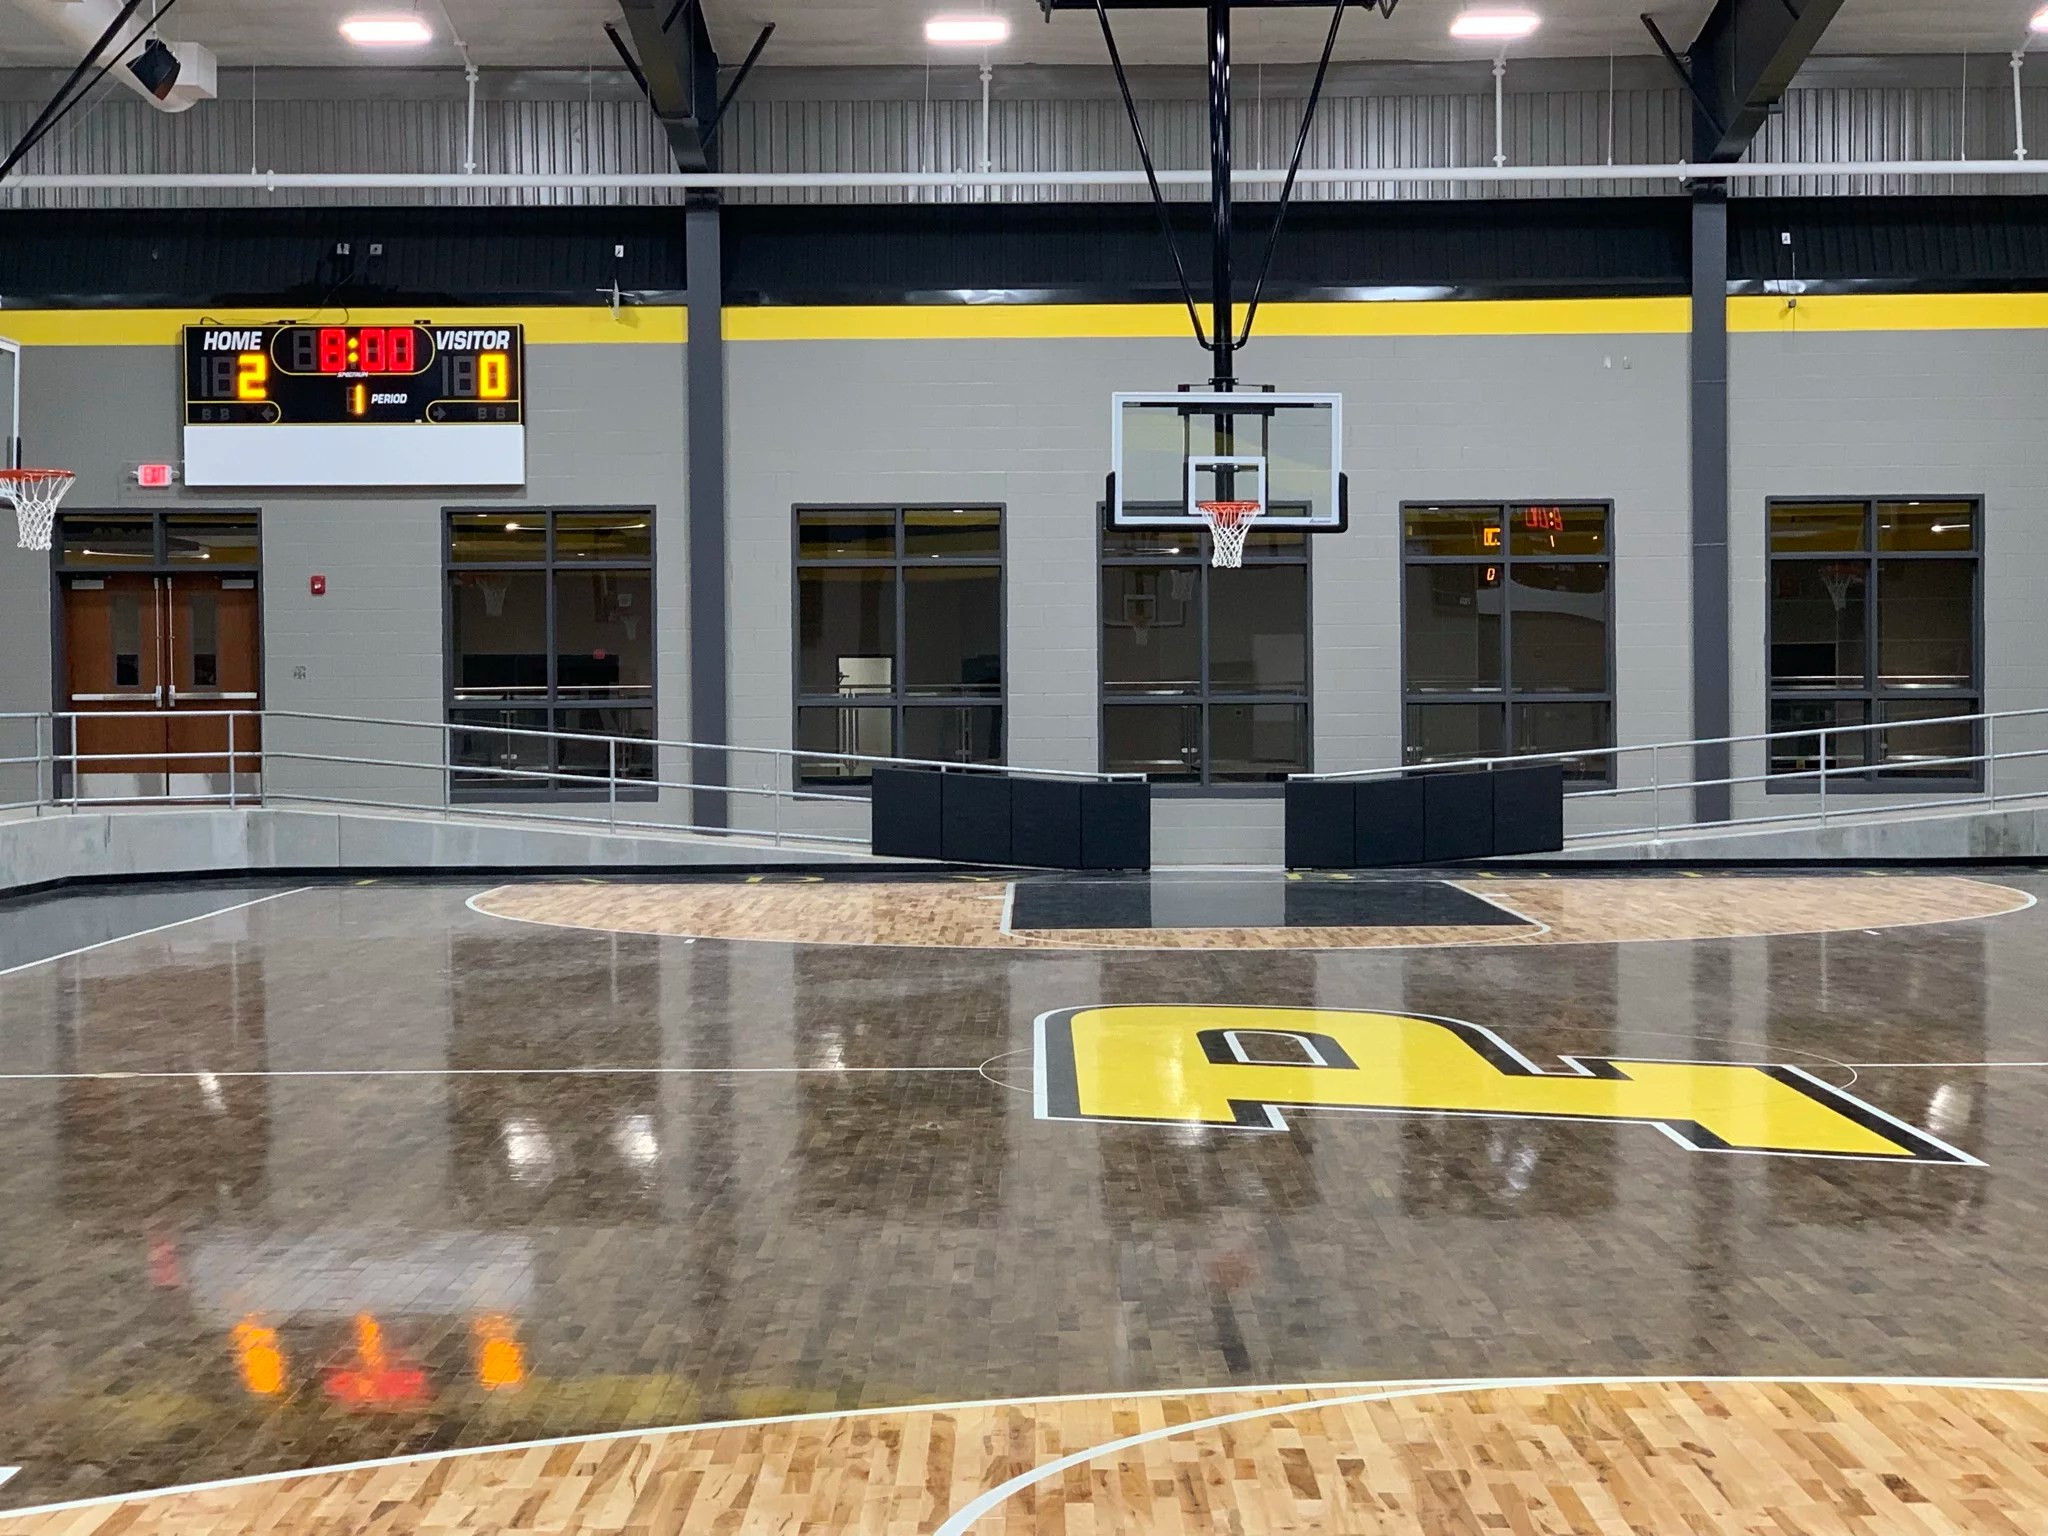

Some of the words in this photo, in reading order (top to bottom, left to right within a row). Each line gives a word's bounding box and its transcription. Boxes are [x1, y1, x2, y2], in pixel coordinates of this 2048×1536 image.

[203, 331, 263, 351] HOME
[321, 329, 414, 372] 8:00
[436, 330, 511, 350] VISITOR
[238, 353, 267, 399] 2
[479, 353, 508, 398] 0
[371, 393, 408, 405] PERIOD
